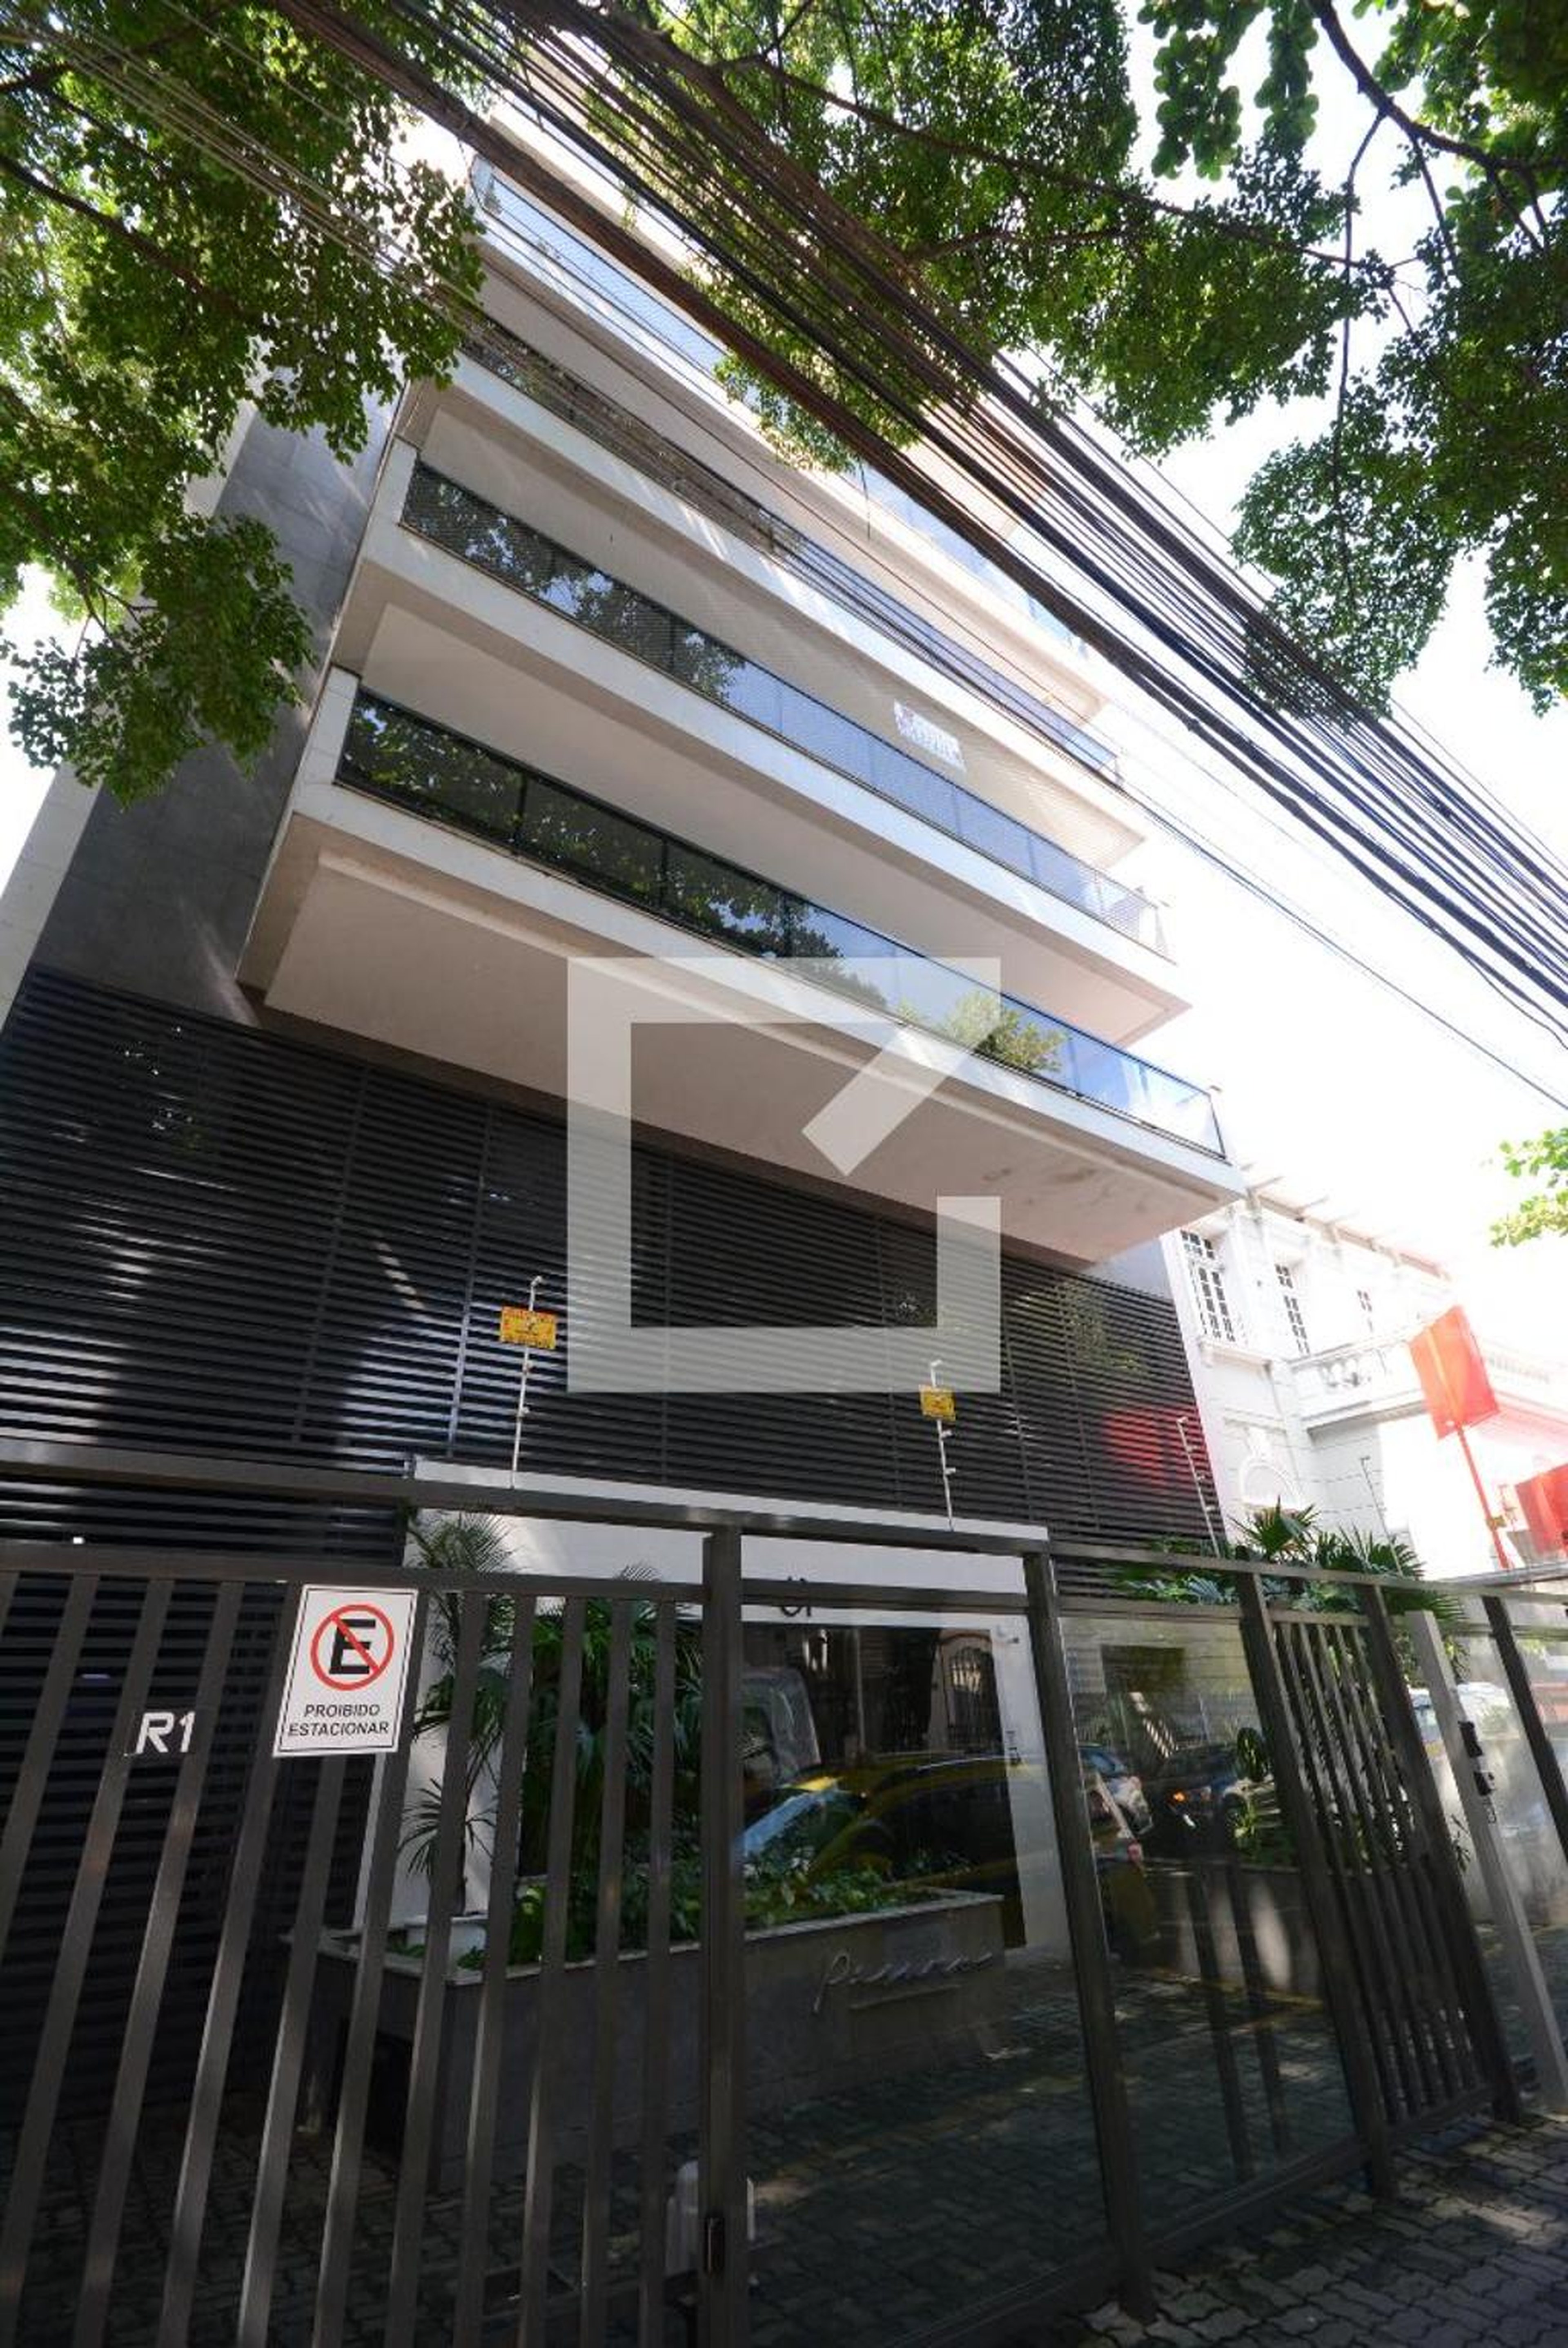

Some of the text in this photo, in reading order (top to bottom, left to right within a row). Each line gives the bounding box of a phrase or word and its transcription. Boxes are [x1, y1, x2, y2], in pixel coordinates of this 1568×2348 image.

[304, 1704, 380, 1717] PROIBIDO
[136, 1711, 195, 1753] R1
[288, 1721, 389, 1737] ESTACIONAR
